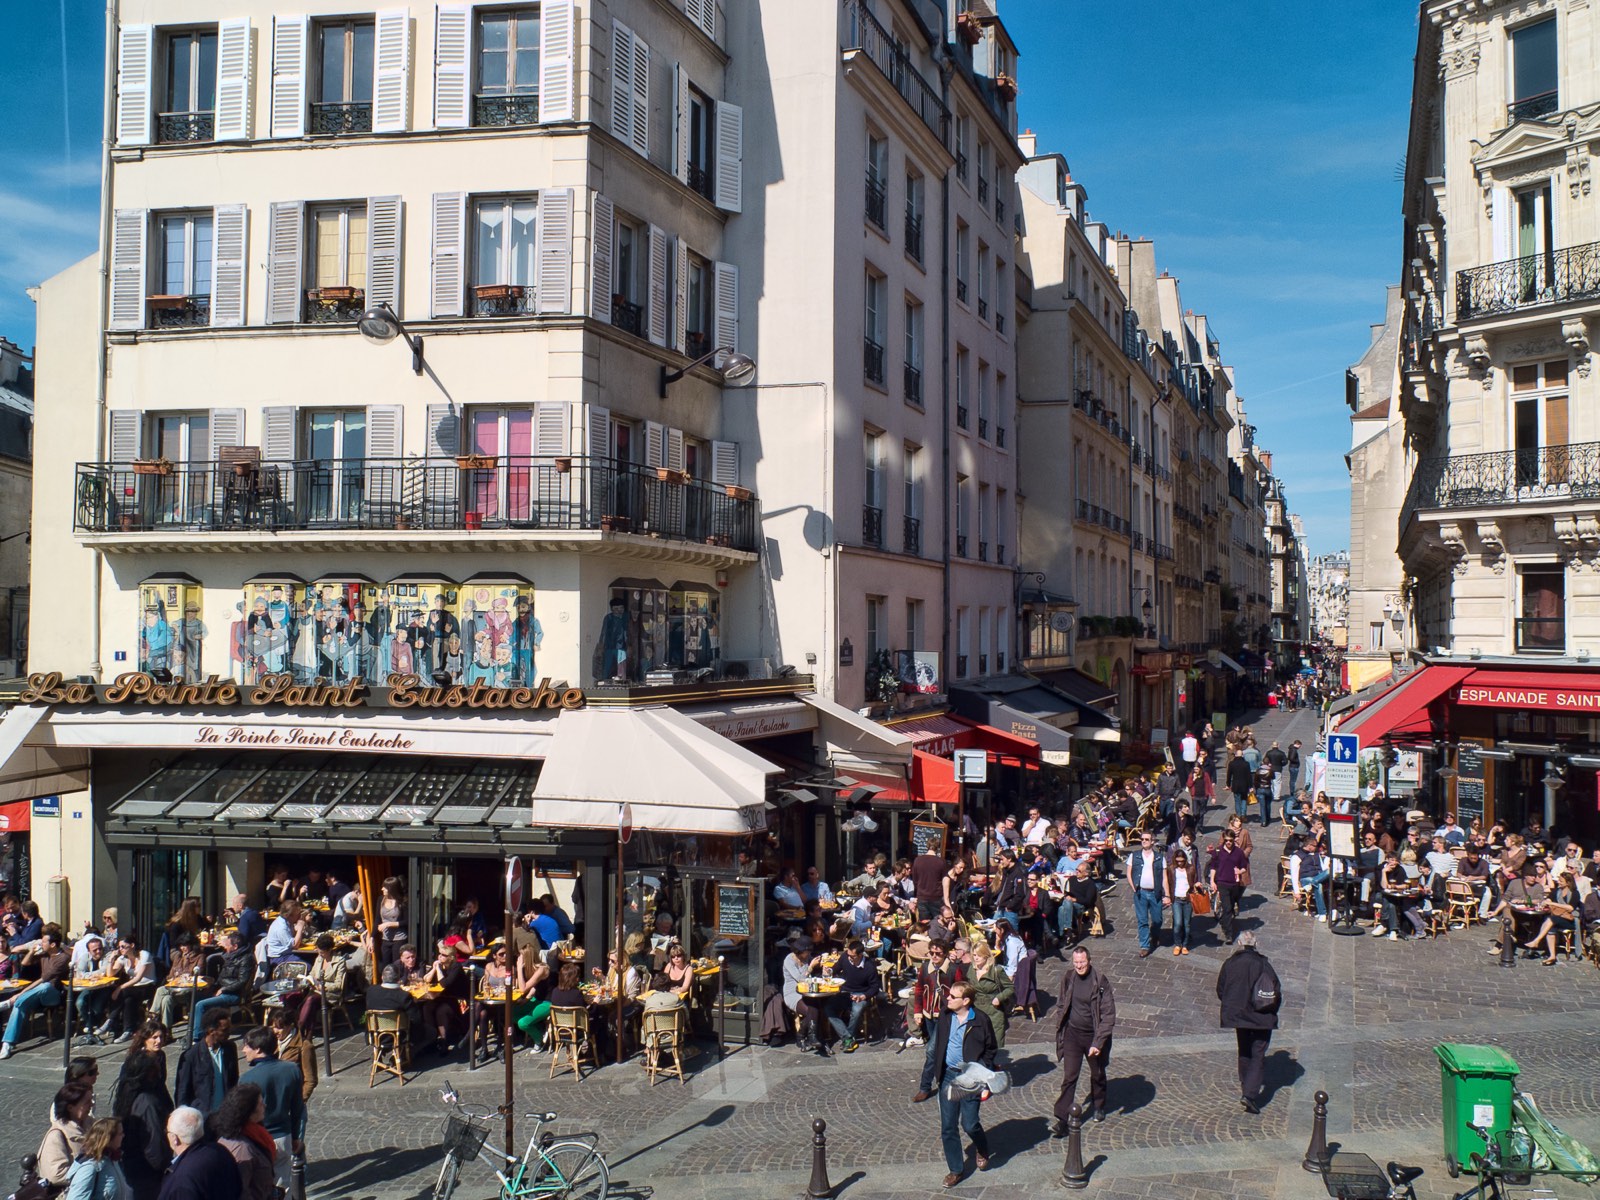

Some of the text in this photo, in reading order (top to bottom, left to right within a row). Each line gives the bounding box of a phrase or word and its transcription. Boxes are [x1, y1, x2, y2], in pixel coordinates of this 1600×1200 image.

[19, 671, 584, 710] La Pointe Saint Eustache
[1448, 689, 1600, 707] L'ESPLANADE SAINT
[734, 721, 758, 738] Saint
[759, 716, 790, 734] Eustache
[1011, 721, 1036, 731] Pizza
[1011, 729, 1036, 739] Pasta
[195, 726, 415, 749] La Pointe Saint Eustache
